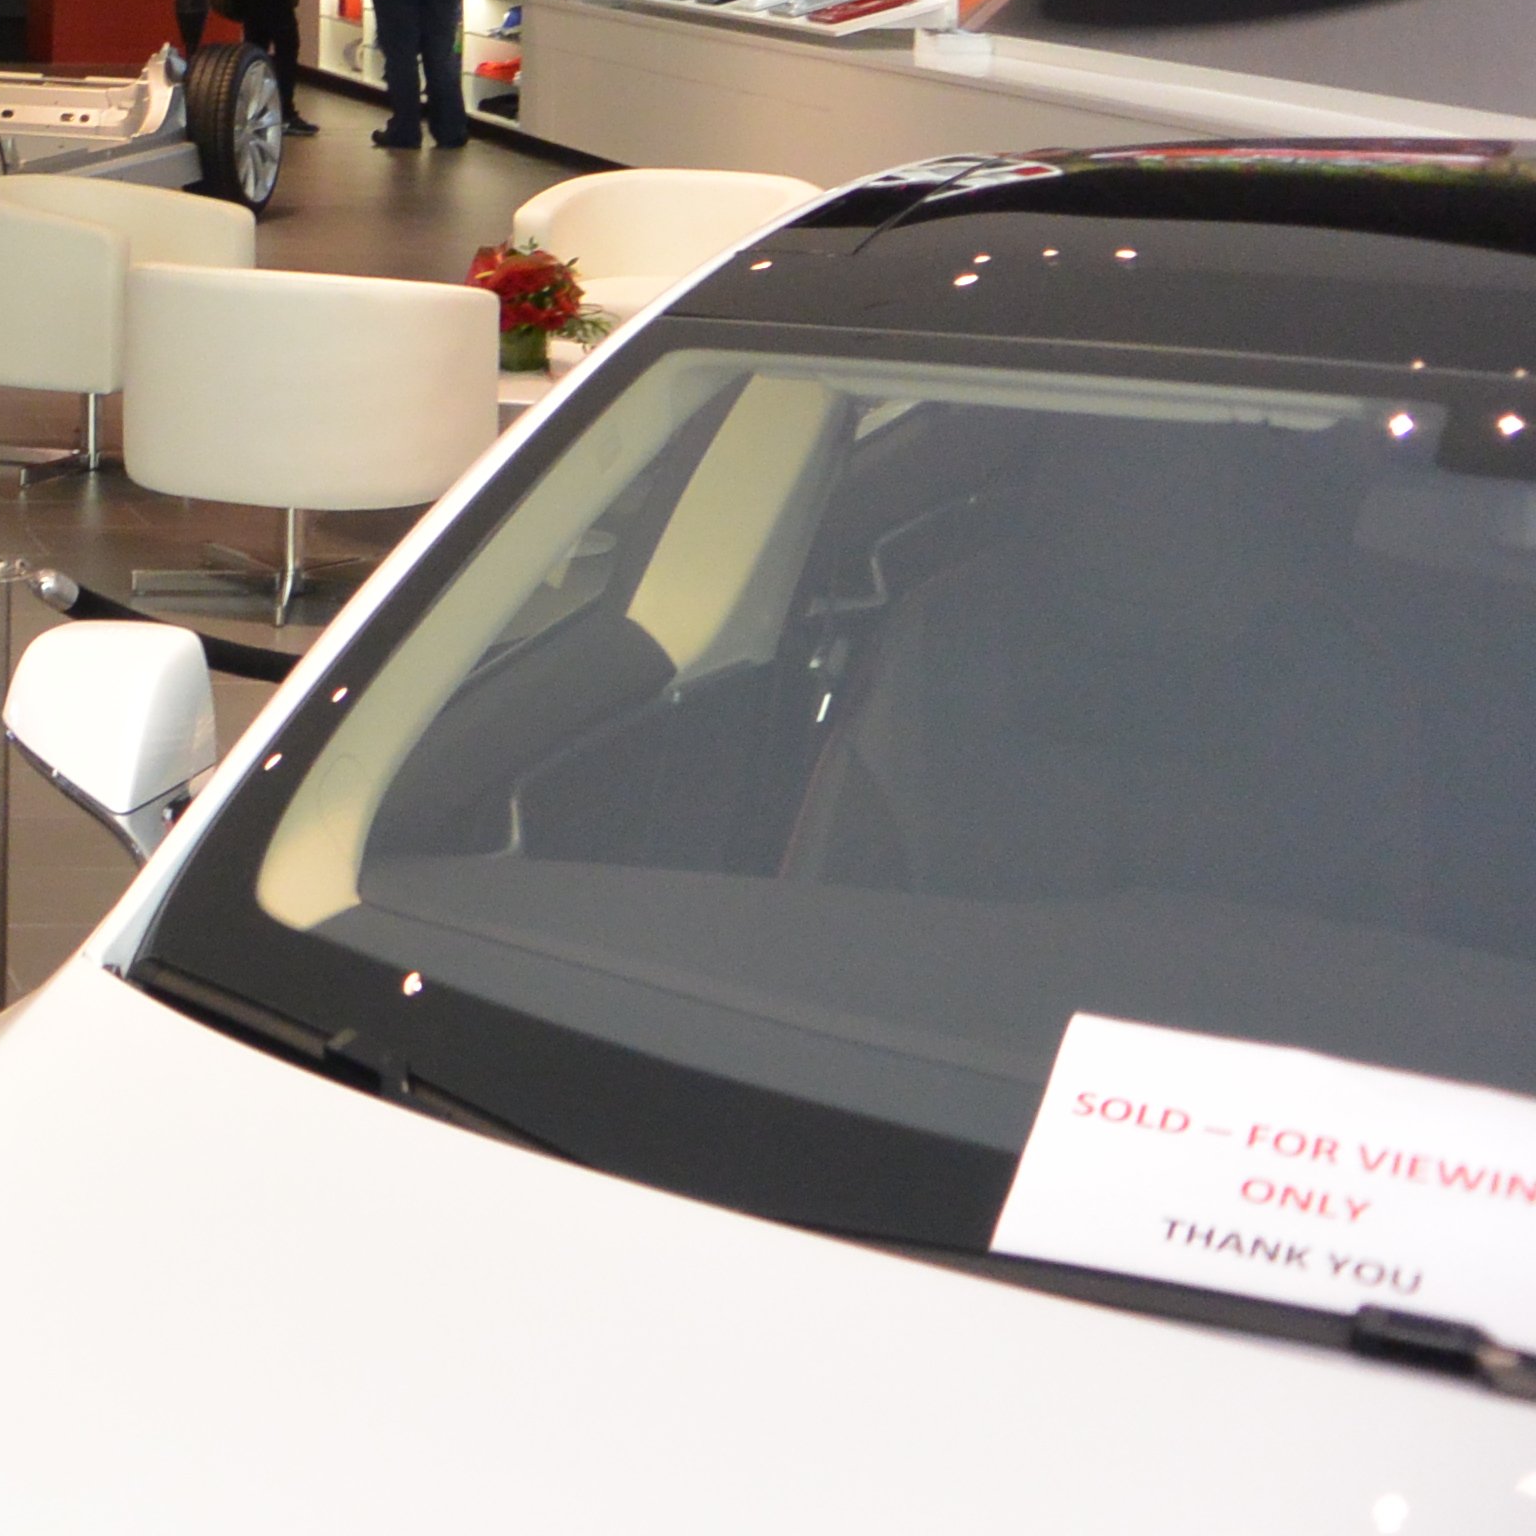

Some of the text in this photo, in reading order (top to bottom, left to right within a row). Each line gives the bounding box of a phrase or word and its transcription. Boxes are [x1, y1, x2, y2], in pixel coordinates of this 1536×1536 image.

[1072, 1092, 1192, 1134] SOLD
[1246, 1124, 1340, 1163] FOR
[1240, 1178, 1372, 1223] ONLY
[1164, 1216, 1424, 1295] THANK YOU
